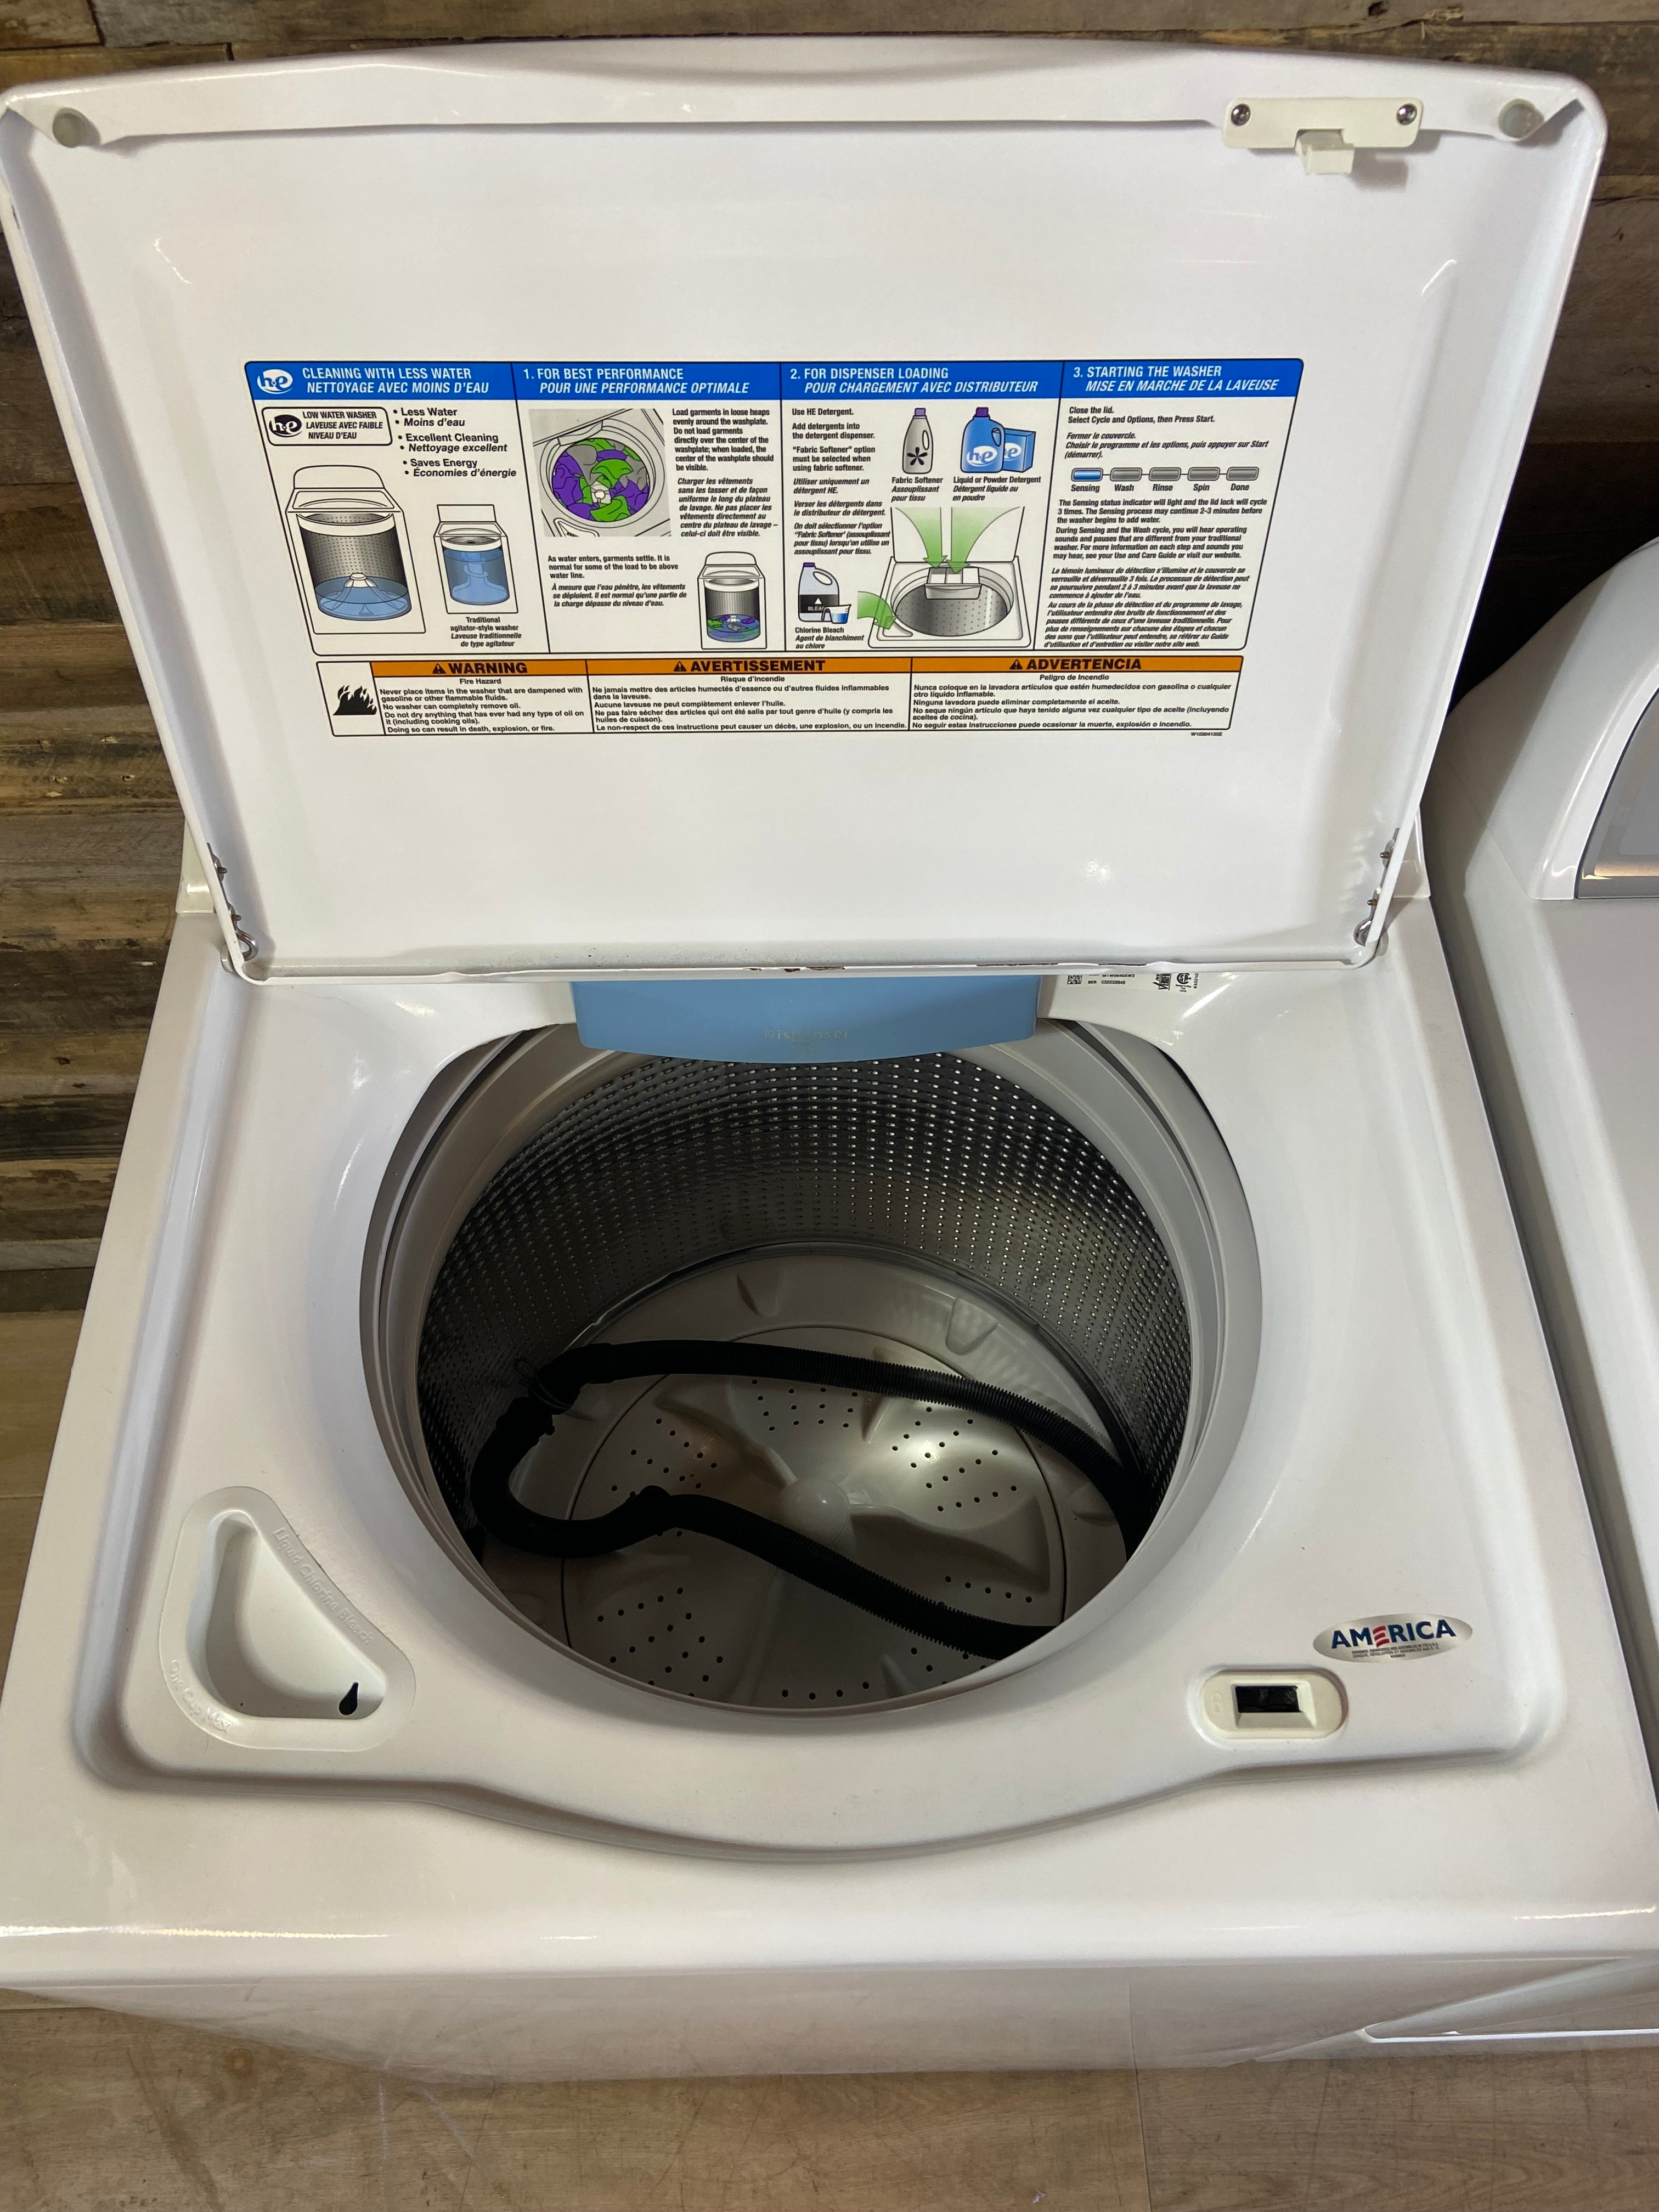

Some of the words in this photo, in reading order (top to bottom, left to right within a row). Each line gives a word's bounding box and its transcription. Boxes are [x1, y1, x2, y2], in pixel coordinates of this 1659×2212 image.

[302, 368, 362, 379] CLEANING
[364, 368, 395, 379] WITH
[398, 368, 428, 379] LESS
[431, 368, 471, 379] WATER
[523, 369, 534, 379] 1.
[537, 368, 560, 379] FOR
[564, 368, 592, 379] BEST
[597, 368, 684, 379] PERFORMANCE
[791, 369, 800, 379] 2.
[805, 369, 826, 379] FOR
[831, 368, 894, 379] DISPENSER
[899, 368, 948, 379] LOADING
[1074, 368, 1082, 377] 3.
[1087, 366, 1143, 377] STARTING
[1148, 366, 1169, 377] THE
[1173, 366, 1222, 377] WASHER
[307, 382, 374, 393] NETTOYAGE
[377, 382, 408, 393] AVEC
[412, 382, 450, 393] MOINS
[454, 382, 489, 393] D'EAU
[540, 382, 571, 393] POUR
[575, 382, 598, 393] UNE
[601, 382, 688, 393] PERFORMANCE
[691, 382, 749, 393] OPTIMALE
[805, 382, 836, 393] POUR
[839, 382, 919, 393] CHARGEMENT
[921, 382, 952, 392] AVEC
[955, 381, 1038, 392] DISTRIBUTEUR
[1086, 381, 1116, 391] MISE
[1118, 381, 1135, 391] EN
[1136, 380, 1188, 391] MARCHE
[1189, 380, 1206, 391] DE
[1207, 380, 1223, 391] LA
[1226, 380, 1279, 390] LAVEUSE
[400, 407, 425, 416] Less
[427, 408, 458, 416] Water
[690, 409, 721, 417] garments
[750, 408, 770, 416] heaps
[818, 408, 854, 416] Detergent.
[404, 418, 434, 426] Moins
[437, 418, 465, 426] d'eau
[1092, 416, 1110, 424] Cycle
[1127, 415, 1155, 424] Options,
[808, 422, 844, 431] detergents
[405, 433, 452, 442] Excellent
[454, 433, 498, 443] Cleaning
[805, 432, 838, 441] detergent
[840, 432, 875, 440] dispenser.
[409, 443, 460, 454] Nettoyage
[462, 443, 507, 452] excellent
[443, 459, 477, 469] Energy
[413, 467, 467, 476] Économies
[471, 468, 516, 478] d'énergie
[953, 476, 973, 484] Liquid
[1009, 476, 1041, 484] Detergent
[891, 486, 939, 494] Assouplissant
[953, 485, 985, 493] Détergent
[986, 485, 1008, 493] liquide
[1071, 484, 1100, 493] Sensing
[1193, 483, 1210, 492] Spin
[449, 662, 527, 674] WARNING
[691, 660, 825, 672] AVERTISSEMENT
[1026, 658, 1141, 670] ADVERTENCIA
[764, 1029, 850, 1042] Dispenser
[273, 1528, 303, 1566] Liquid
[298, 1561, 338, 1612] Chlorine
[335, 1605, 374, 1645] Bleach
[1331, 1619, 1457, 1649] AMERICA
[200, 1707, 232, 1733] Max
